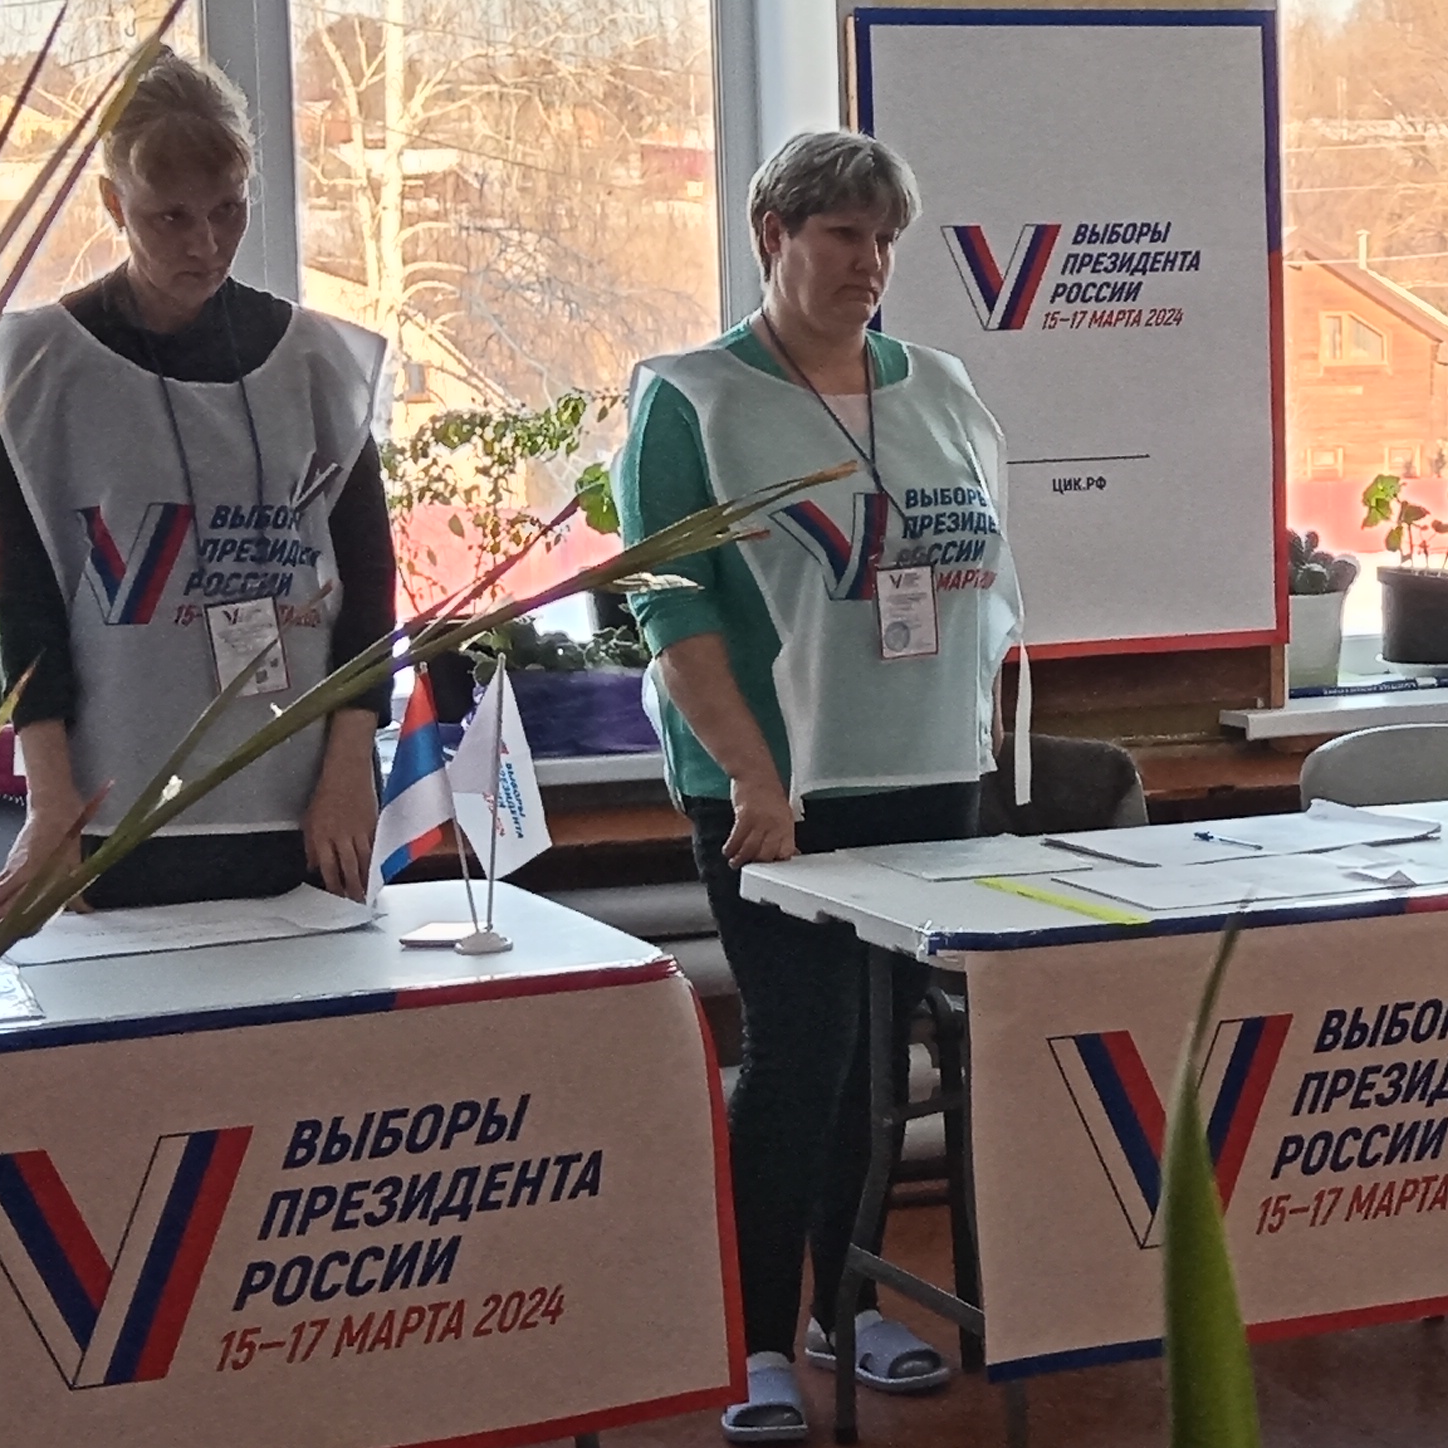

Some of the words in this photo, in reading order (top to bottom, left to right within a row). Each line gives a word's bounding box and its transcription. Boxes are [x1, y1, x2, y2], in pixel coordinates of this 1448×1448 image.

[1071, 221, 1172, 246] ВЫБОРЫ
[1060, 250, 1202, 276] ПРЕЗИДЕНТА
[1050, 281, 1144, 304] РОССИИ
[1089, 309, 1142, 329] МАРТА
[1145, 307, 1185, 327] 2024
[1052, 475, 1107, 493] ЦИК.РФ
[282, 1093, 531, 1170] ВЫБОРЫ
[257, 1149, 604, 1241] ПРЕЗИДЕНТА
[232, 1236, 461, 1311] РОССИИ
[335, 1297, 466, 1355] МАРТА
[472, 1284, 564, 1337] 2024
